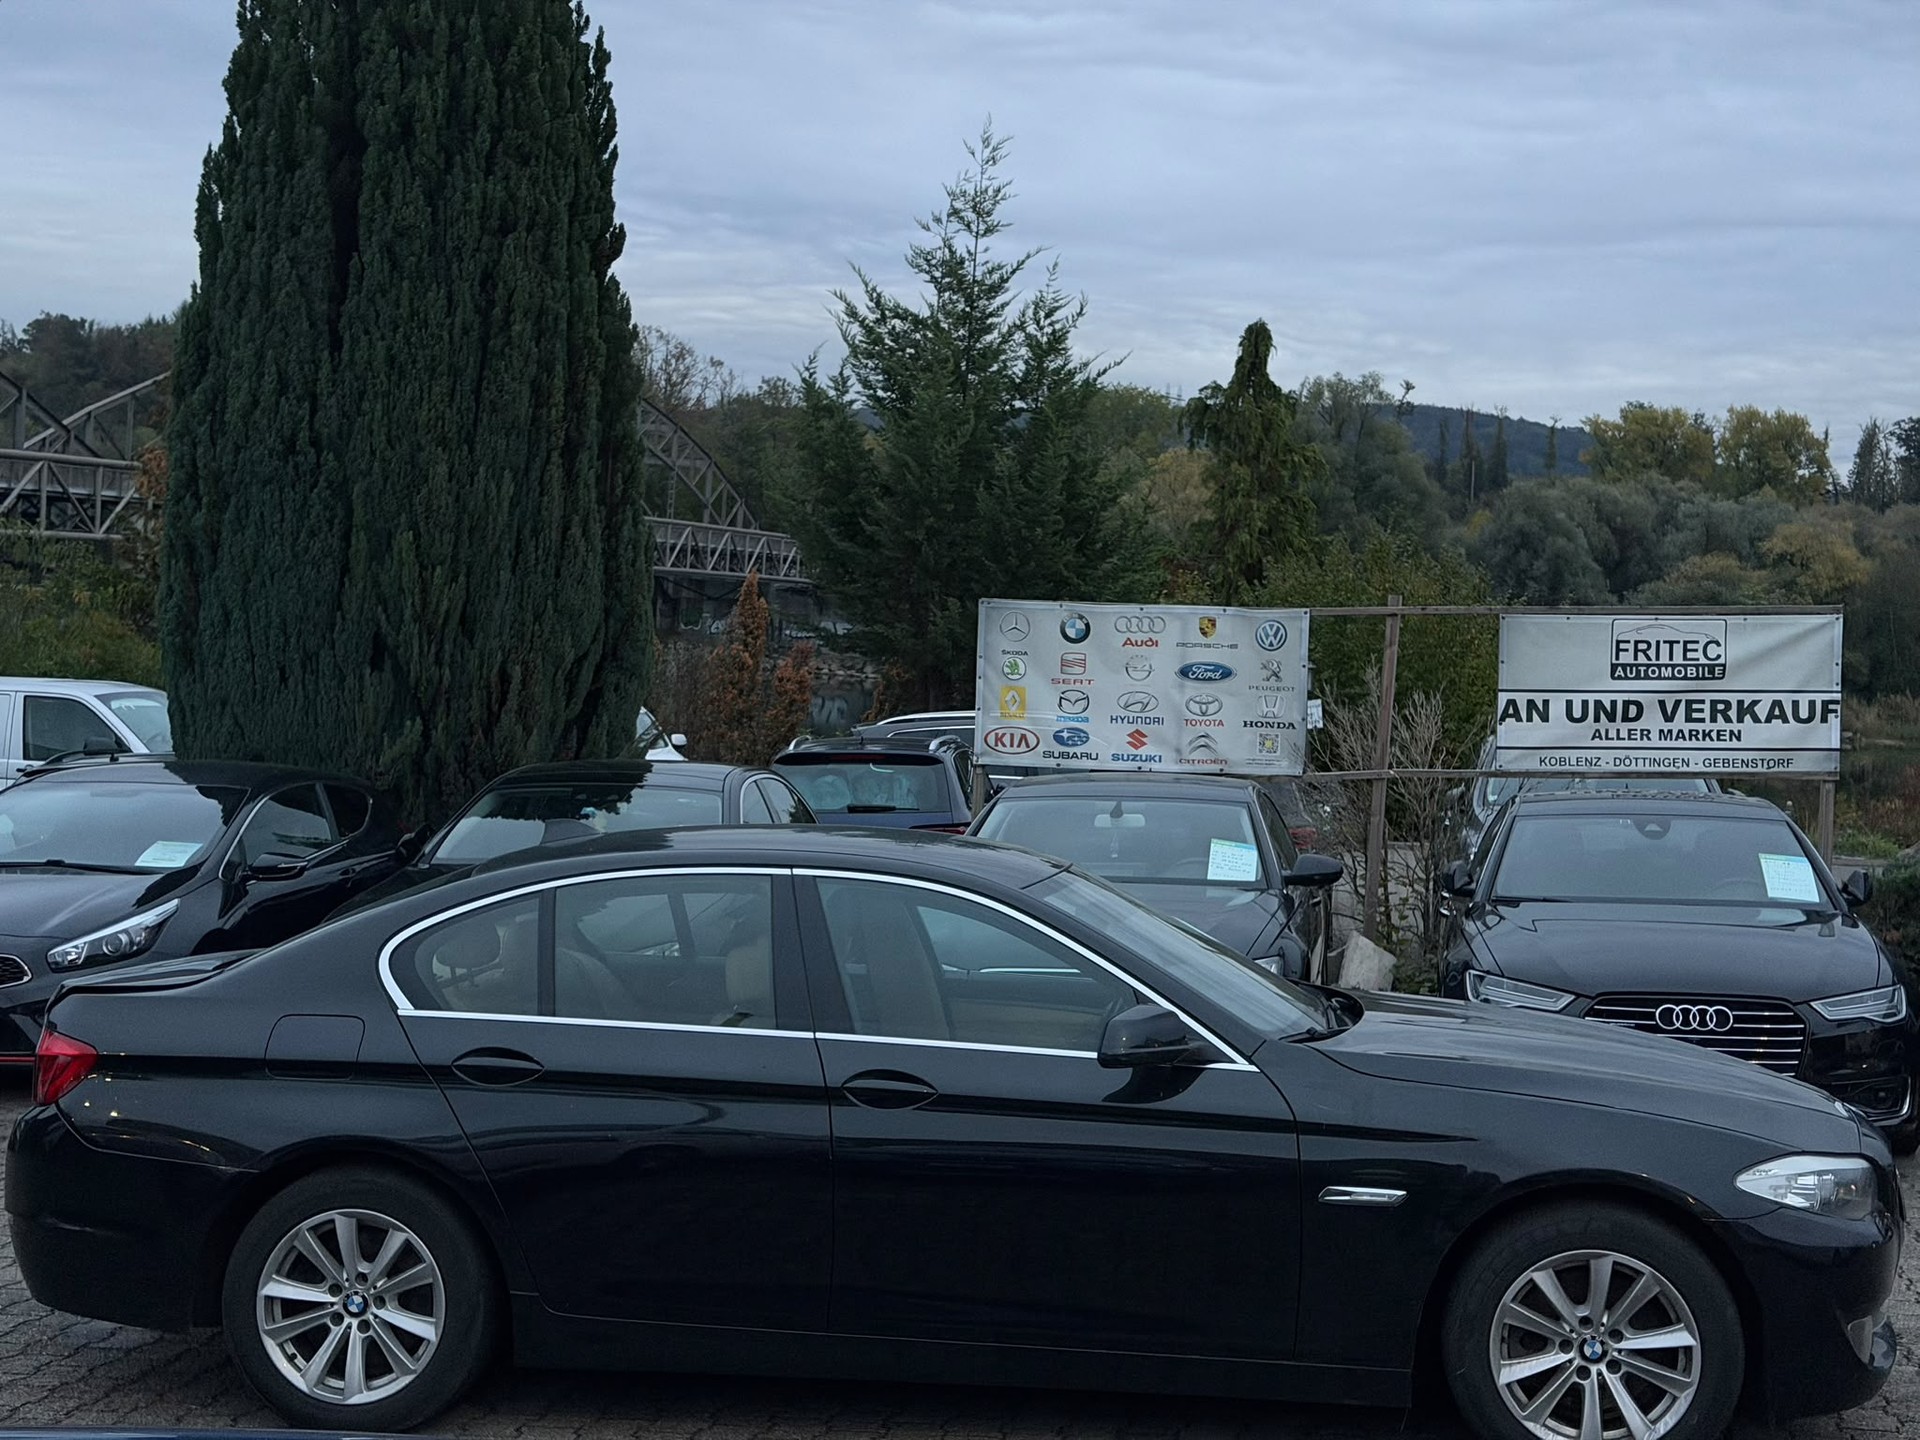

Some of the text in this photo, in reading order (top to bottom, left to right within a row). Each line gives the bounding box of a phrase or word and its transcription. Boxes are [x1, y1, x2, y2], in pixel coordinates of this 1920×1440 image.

[1122, 637, 1159, 648] Audi
[1176, 642, 1239, 650] PORSCHE
[1615, 640, 1722, 662] FRITEC
[1188, 664, 1223, 680] Ford
[1614, 667, 1724, 678] AUTOMOBILE
[1051, 678, 1095, 686] SEAT
[1499, 699, 1840, 725] AN UND VERKAUF
[1110, 715, 1164, 726] HYUNDAI
[1184, 719, 1225, 727] TOYOTA
[1243, 720, 1297, 730] HONDA
[994, 732, 1031, 749] KIA
[1591, 728, 1742, 742] ALLER MARKEN
[1042, 750, 1099, 761] SUBARU
[1111, 753, 1162, 763] SUZUKI
[1539, 756, 1602, 768] KOBLENZ
[1613, 755, 1690, 769] DÖTTINGEN
[1702, 758, 1795, 770] GEBENSTORF
